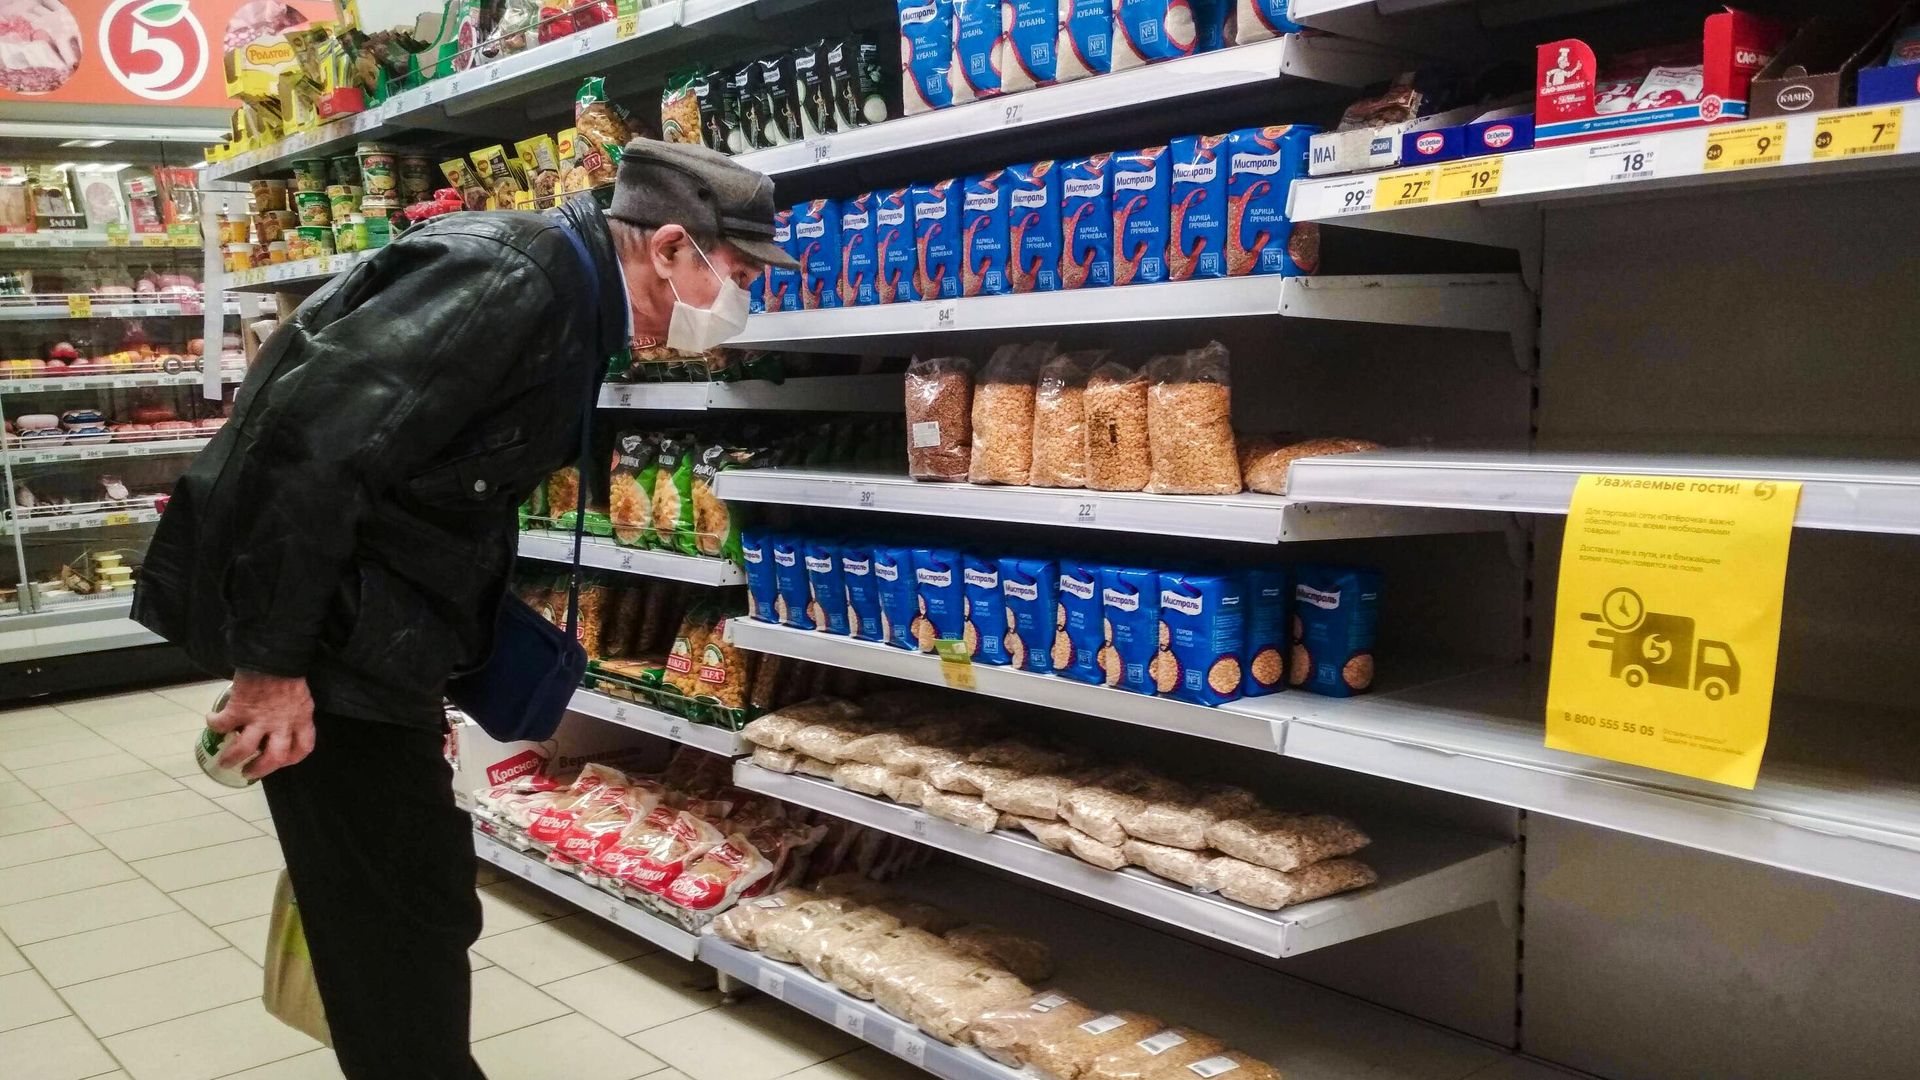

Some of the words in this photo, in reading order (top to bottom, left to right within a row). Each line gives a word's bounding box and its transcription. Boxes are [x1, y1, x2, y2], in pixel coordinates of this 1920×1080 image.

[1077, 8, 1104, 18] КУБАНЬ
[1019, 18, 1046, 28] КУБАНЬ
[962, 29, 983, 39] КУБАНЬ
[1141, 26, 1156, 38] №1
[1090, 41, 1105, 51] №1
[916, 50, 938, 61] КУБАНЬ
[1033, 49, 1048, 60] №1
[972, 59, 984, 69] №1
[928, 80, 940, 91] №1
[1780, 91, 1811, 103] KAMIS
[1006, 106, 1018, 118] 97
[1873, 124, 1885, 143] 7
[1757, 137, 1770, 155] 9
[815, 147, 827, 159] 118
[1234, 158, 1278, 171] Мистраль
[1623, 154, 1644, 172] 18
[1116, 175, 1154, 187] Мистраль
[1471, 171, 1489, 188] 19
[1066, 182, 1101, 195] Мистраль
[1402, 182, 1422, 198] 27
[1014, 193, 1044, 204] Мистраль
[1344, 191, 1365, 206] 99
[917, 205, 945, 217] Мистраль
[1251, 207, 1275, 215] ЯДРИЦА
[1189, 214, 1211, 222] ЯДРИЦА
[1250, 214, 1283, 223] ГРЕЧНЕВАЯ
[1130, 226, 1159, 234] ГРЕЧНЕВАЯ
[1189, 221, 1219, 229] ГРЕЧНЕВАЯ
[1080, 232, 1108, 240] ГРЕЧНЕВАЯ
[1202, 258, 1218, 269] №1
[1264, 254, 1282, 266] №1
[1093, 267, 1108, 278] №1
[1142, 263, 1158, 273] №1
[987, 276, 1000, 286] №1
[1040, 276, 1053, 285] №1
[939, 310, 950, 321] 84
[1595, 476, 1685, 492] Уважаемые
[1689, 482, 1740, 495] гости!
[861, 492, 871, 502] 39
[1079, 504, 1091, 517] 22
[1709, 518, 1735, 527] важно
[919, 572, 949, 583] Мистраль
[965, 571, 995, 584] Мистраль
[1006, 583, 1036, 596] Мистраль
[1061, 579, 1092, 595] Мистраль
[1104, 595, 1137, 608] Мистраль
[1163, 596, 1200, 610] Мистраль
[1176, 628, 1193, 636] ГОРОХ
[1564, 712, 1571, 722] 8
[1575, 714, 1596, 727] 800
[1600, 719, 1619, 730] 555
[1623, 723, 1636, 733] 55
[1640, 725, 1655, 736] 05
[491, 758, 539, 784] Красная
[539, 816, 570, 829] ПЕРЬЯ
[565, 837, 600, 850] ПЕРЬЯ
[907, 1042, 918, 1055] 26
